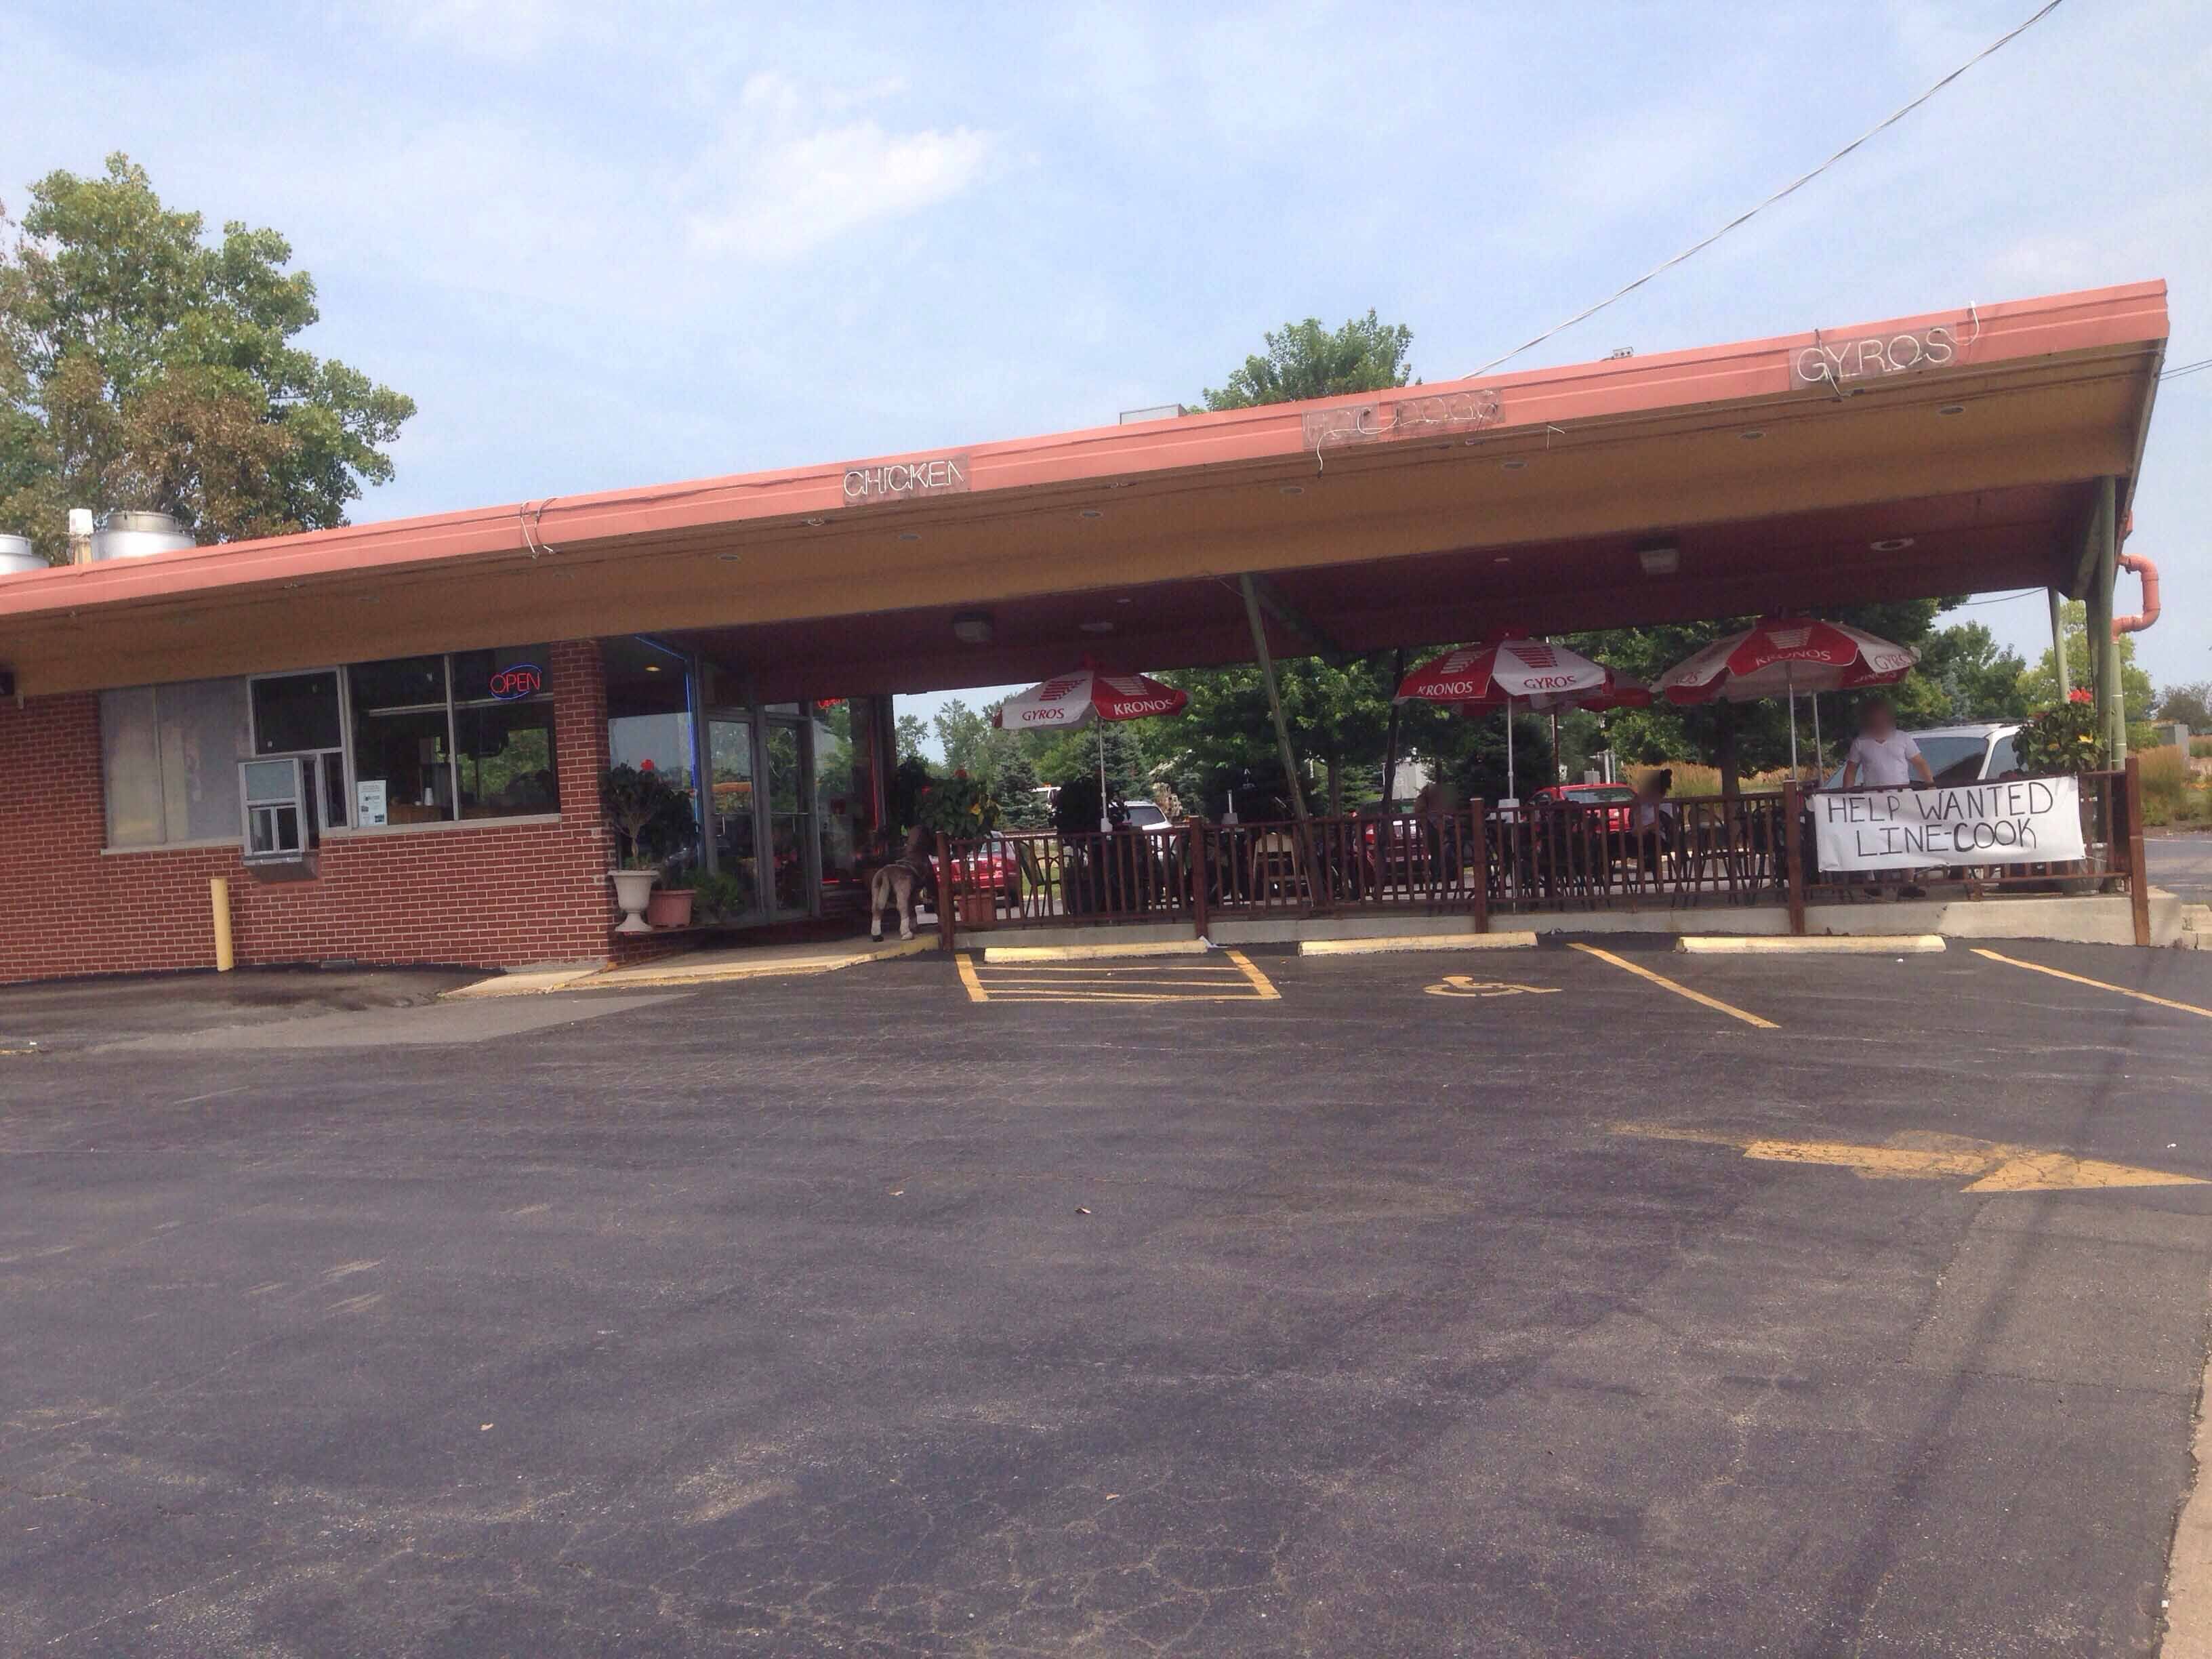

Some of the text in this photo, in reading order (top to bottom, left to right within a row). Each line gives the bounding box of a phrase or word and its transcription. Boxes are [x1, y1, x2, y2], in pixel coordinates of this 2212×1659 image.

[1797, 328, 1952, 382] GYROS
[844, 460, 965, 496] CHICKEN
[490, 672, 540, 693] OPEN
[1416, 680, 1474, 696] KRONOS
[1524, 675, 1577, 690] GYROS
[1022, 708, 1065, 722] GYROS
[1113, 699, 1174, 716] KRONOS
[1827, 781, 2054, 823] HELP WANTED
[1856, 818, 2037, 857] LINE-COOK
